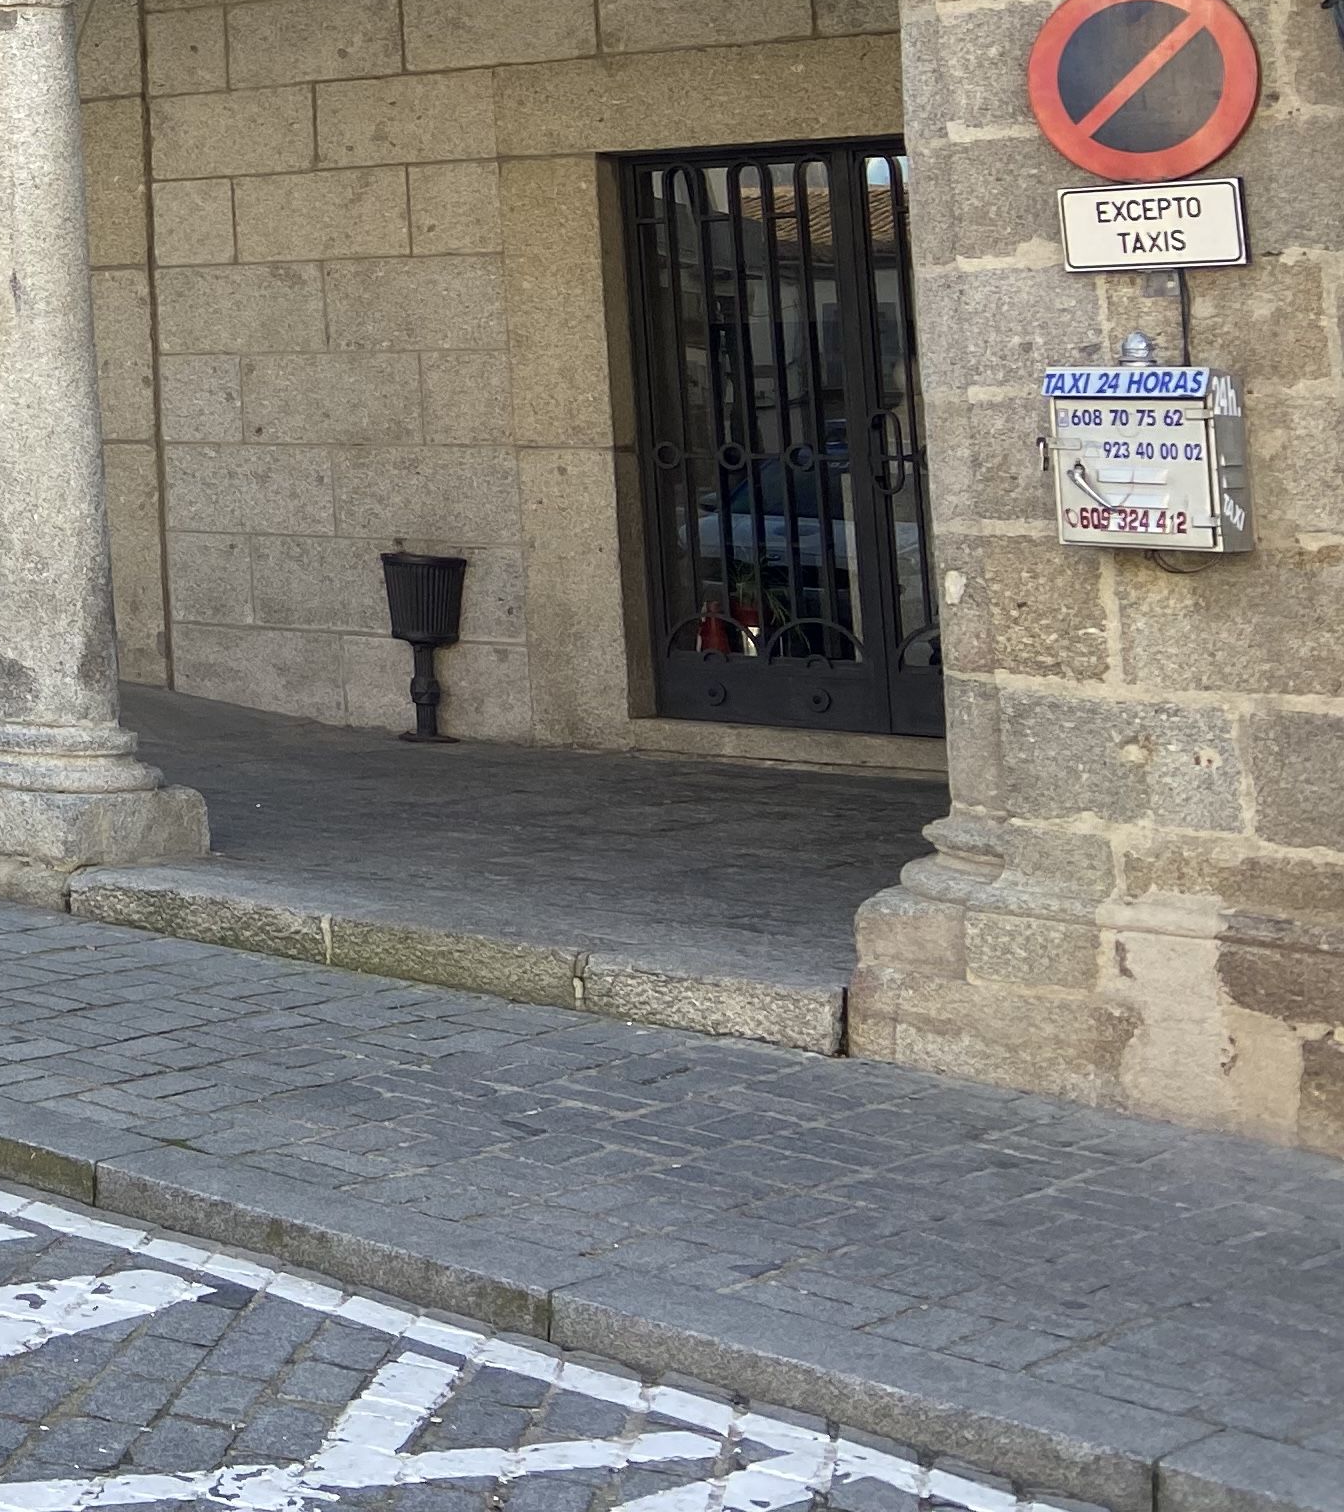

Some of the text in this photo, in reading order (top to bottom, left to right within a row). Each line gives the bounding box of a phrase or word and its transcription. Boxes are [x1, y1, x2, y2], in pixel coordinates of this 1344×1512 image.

[1095, 196, 1202, 224] EXCEPTO
[1117, 229, 1187, 254] TAXIS
[1044, 370, 1204, 394] TAXI 24 HORAS
[1071, 409, 1183, 426] 608 70 75 62
[1103, 441, 1203, 461] 923 40 00 02
[1079, 507, 1111, 531] 609
[1118, 509, 1150, 531] 324
[1223, 493, 1246, 531] TAXI
